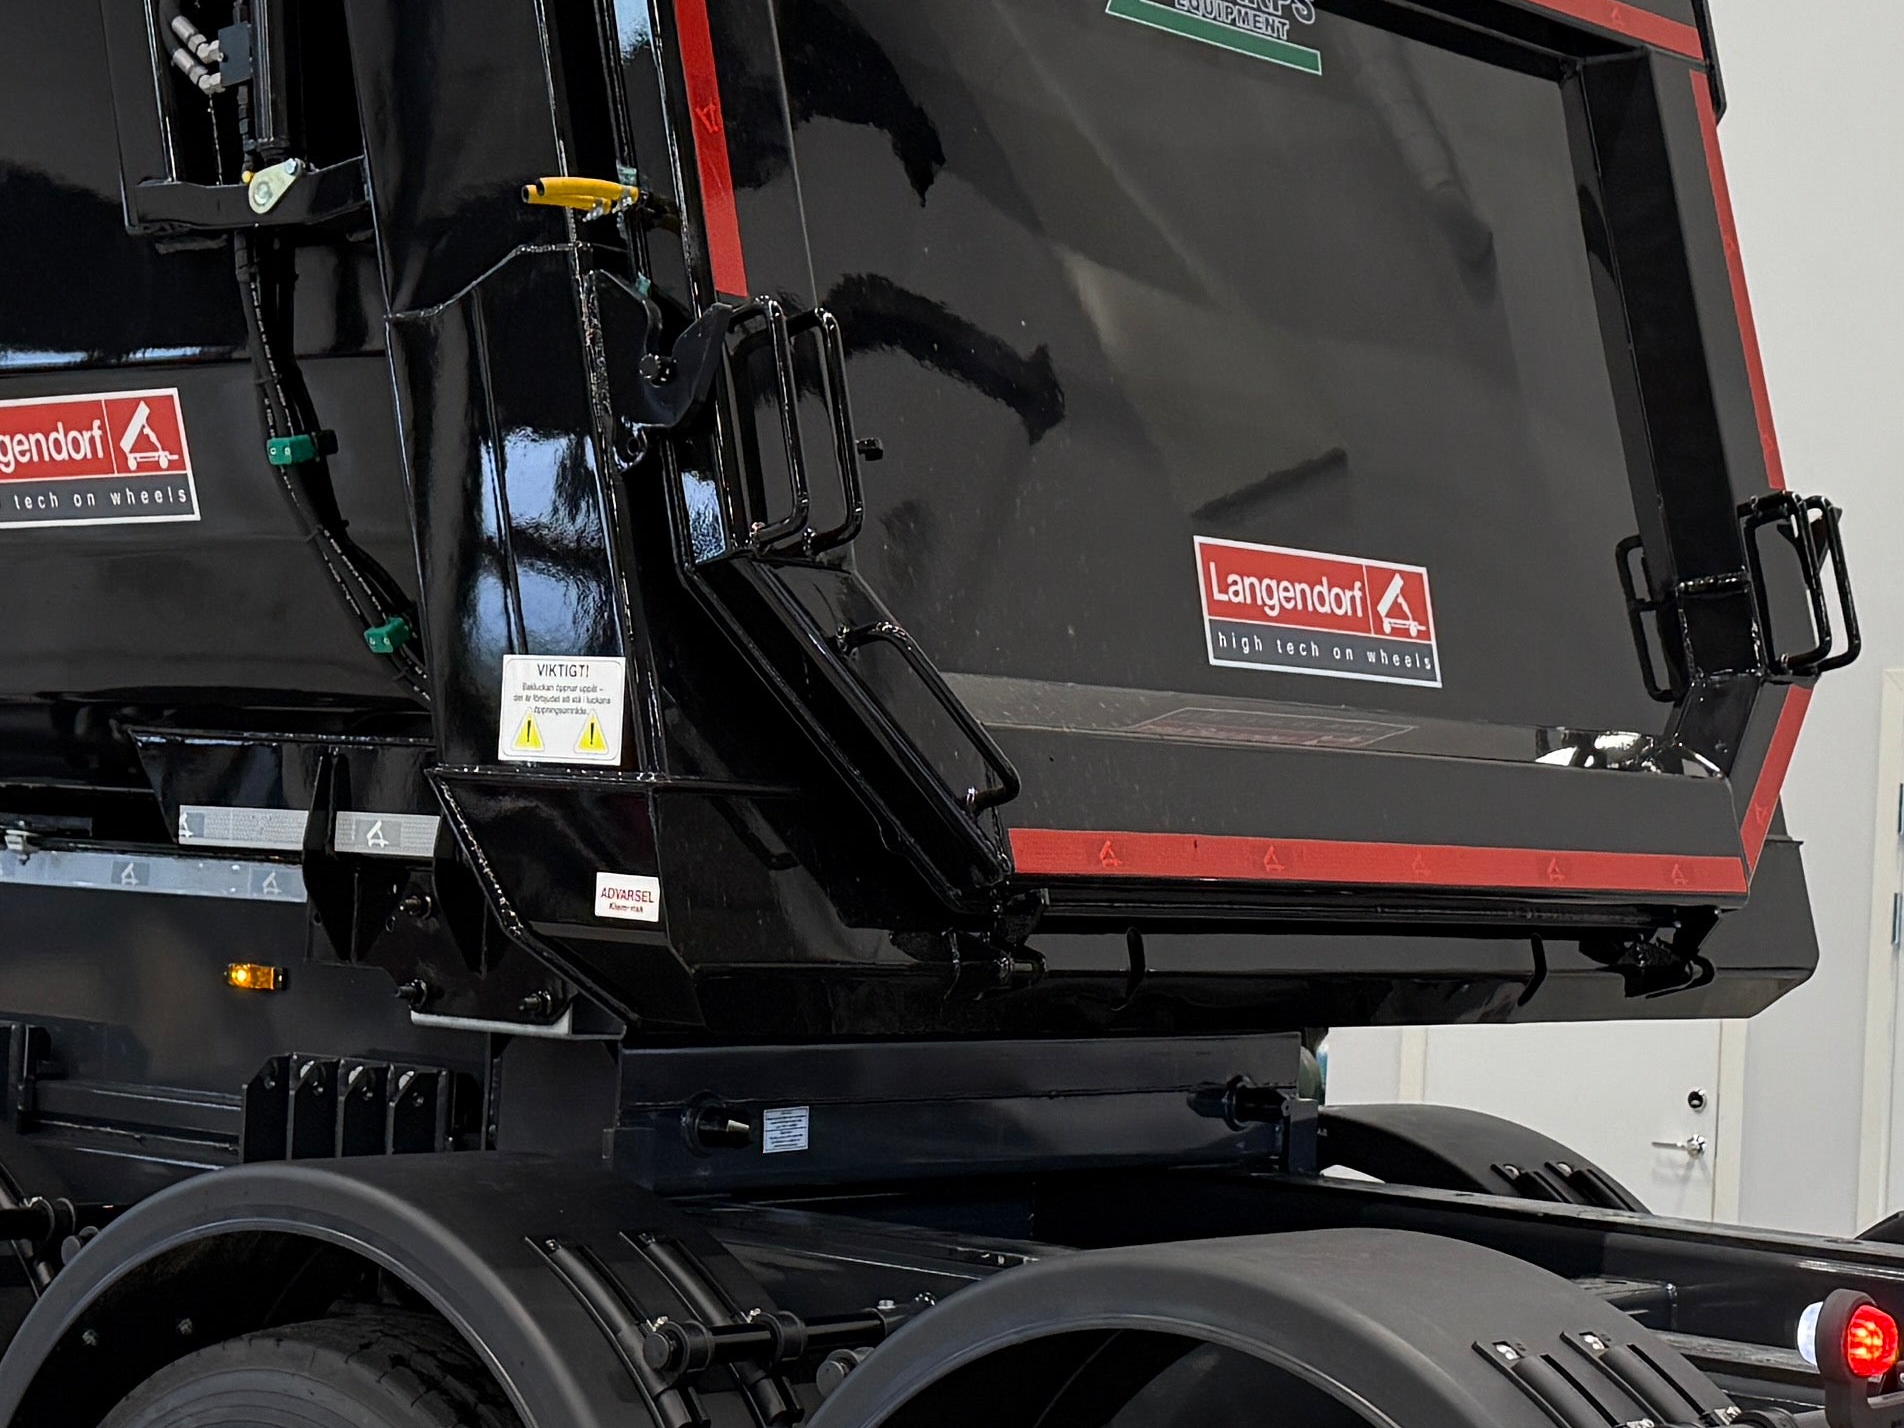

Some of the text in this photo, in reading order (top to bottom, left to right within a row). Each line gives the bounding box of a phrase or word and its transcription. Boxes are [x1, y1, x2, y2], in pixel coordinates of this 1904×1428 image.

[14, 491, 59, 510] tech
[73, 492, 96, 508] on
[110, 486, 187, 506] wheels
[1209, 561, 1363, 618] Langendorf
[1218, 632, 1432, 670] high tech on wheels
[537, 663, 589, 678] VIKTIGT!
[601, 887, 654, 904] ADVARSEL
